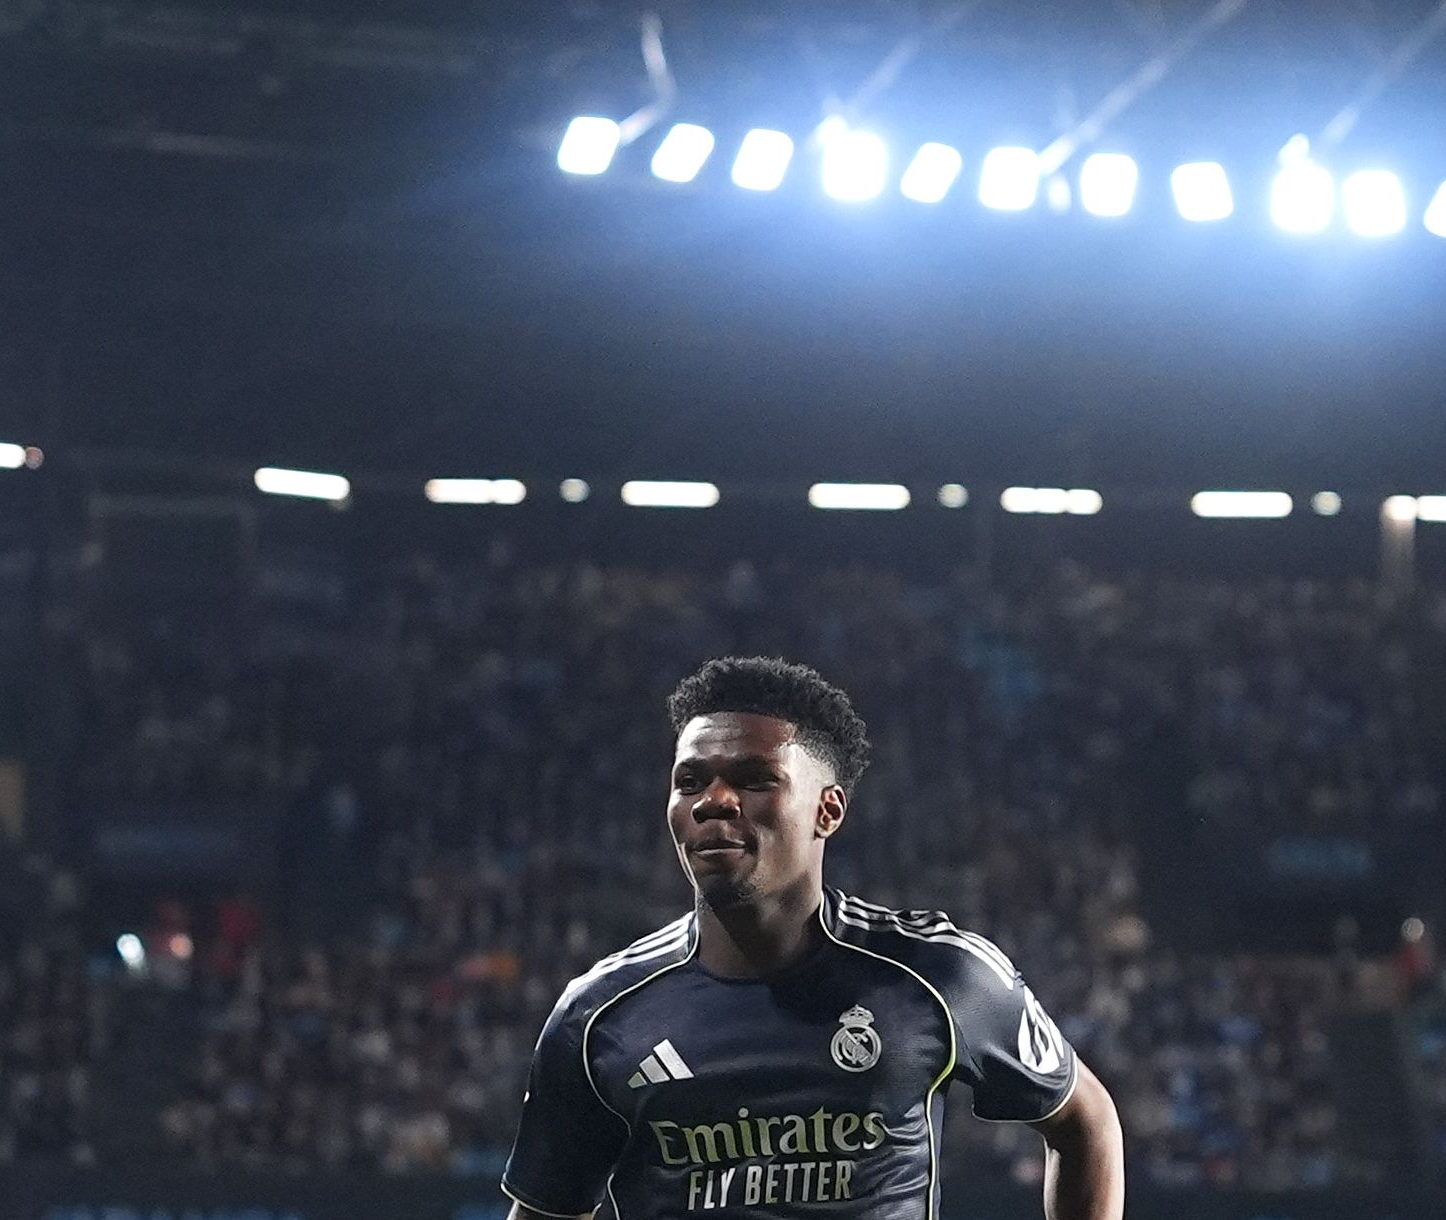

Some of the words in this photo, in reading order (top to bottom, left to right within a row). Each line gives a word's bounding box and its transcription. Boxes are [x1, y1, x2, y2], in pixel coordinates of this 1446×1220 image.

[649, 1104, 887, 1165] Emirates
[687, 1167, 736, 1211] FLY
[744, 1159, 852, 1206] BETTER
